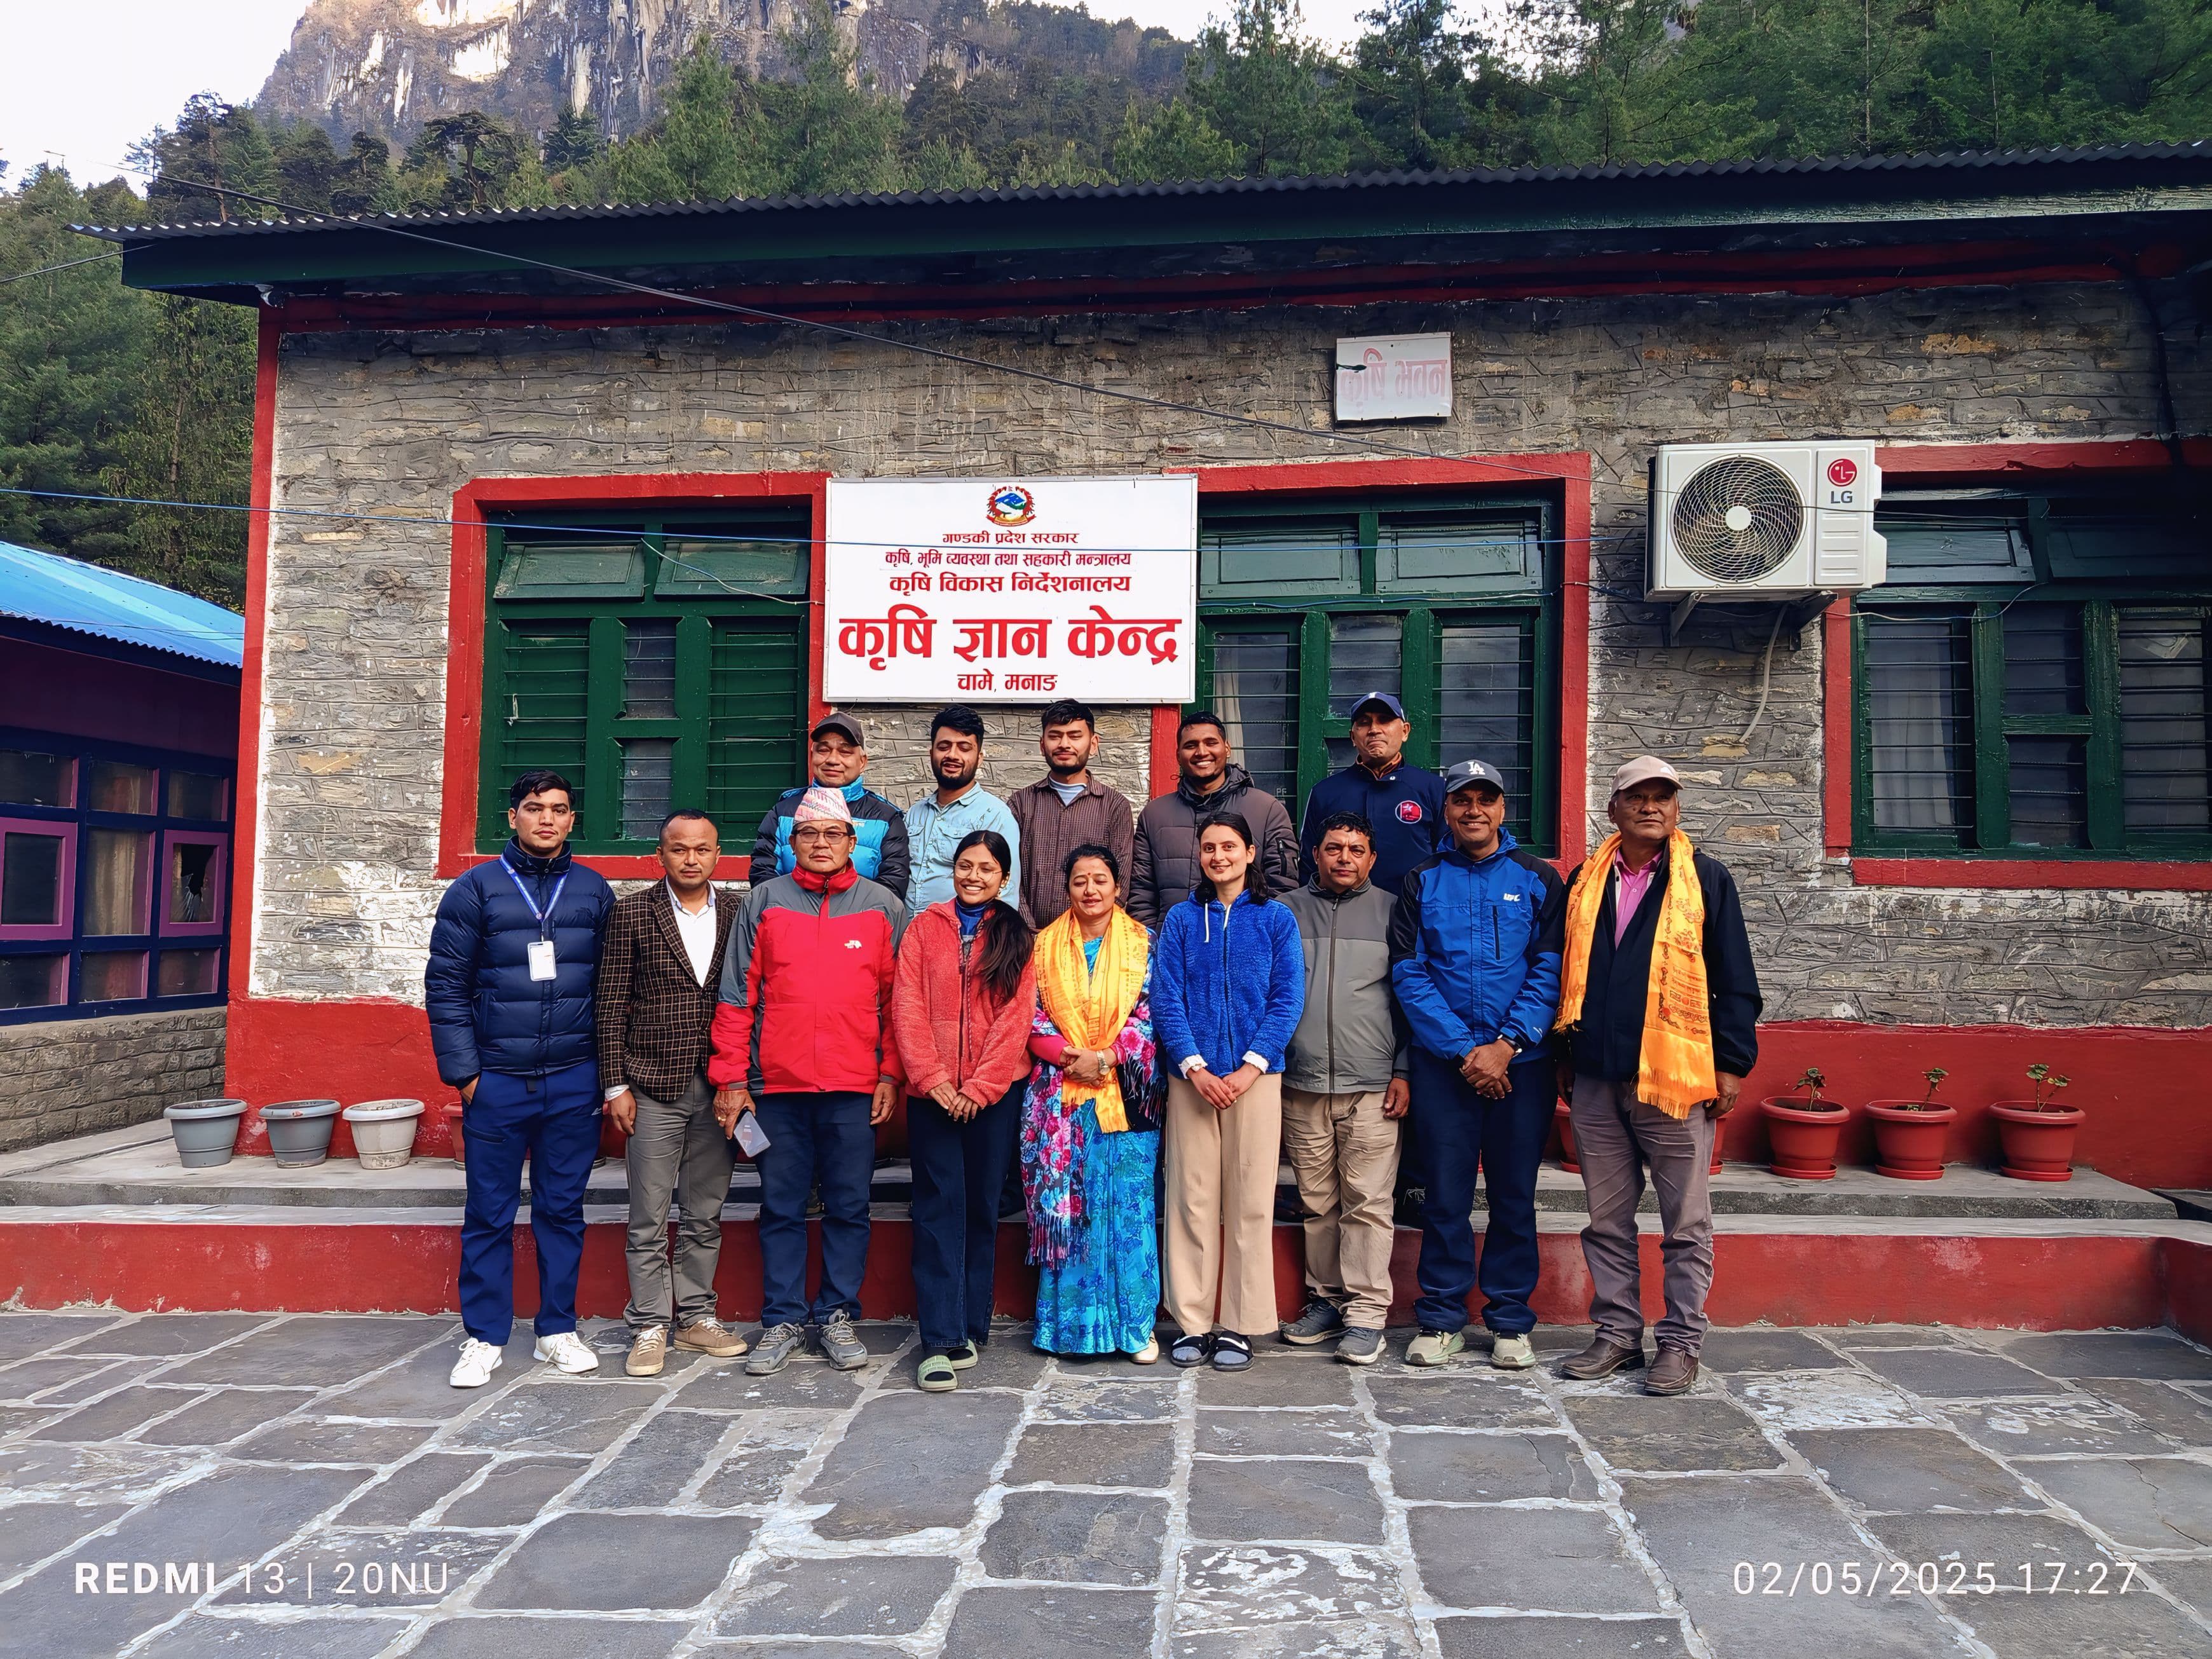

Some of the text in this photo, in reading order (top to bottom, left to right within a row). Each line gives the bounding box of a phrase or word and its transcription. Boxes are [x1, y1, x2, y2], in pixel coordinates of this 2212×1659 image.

[1395, 358, 1448, 400] भवन
[1830, 491, 1853, 504] LG
[943, 529, 1079, 545] गण्डकी प्रदेश सरकार
[885, 549, 1131, 568] कृषि, भूमि व्यवस्था तथा सहकारी मन्त्रालय
[889, 571, 1131, 596] कृषि विकास निर्देशनालय
[838, 603, 1182, 671] कृषि ज्ञान केन्द्र
[957, 668, 997, 693] चामे,
